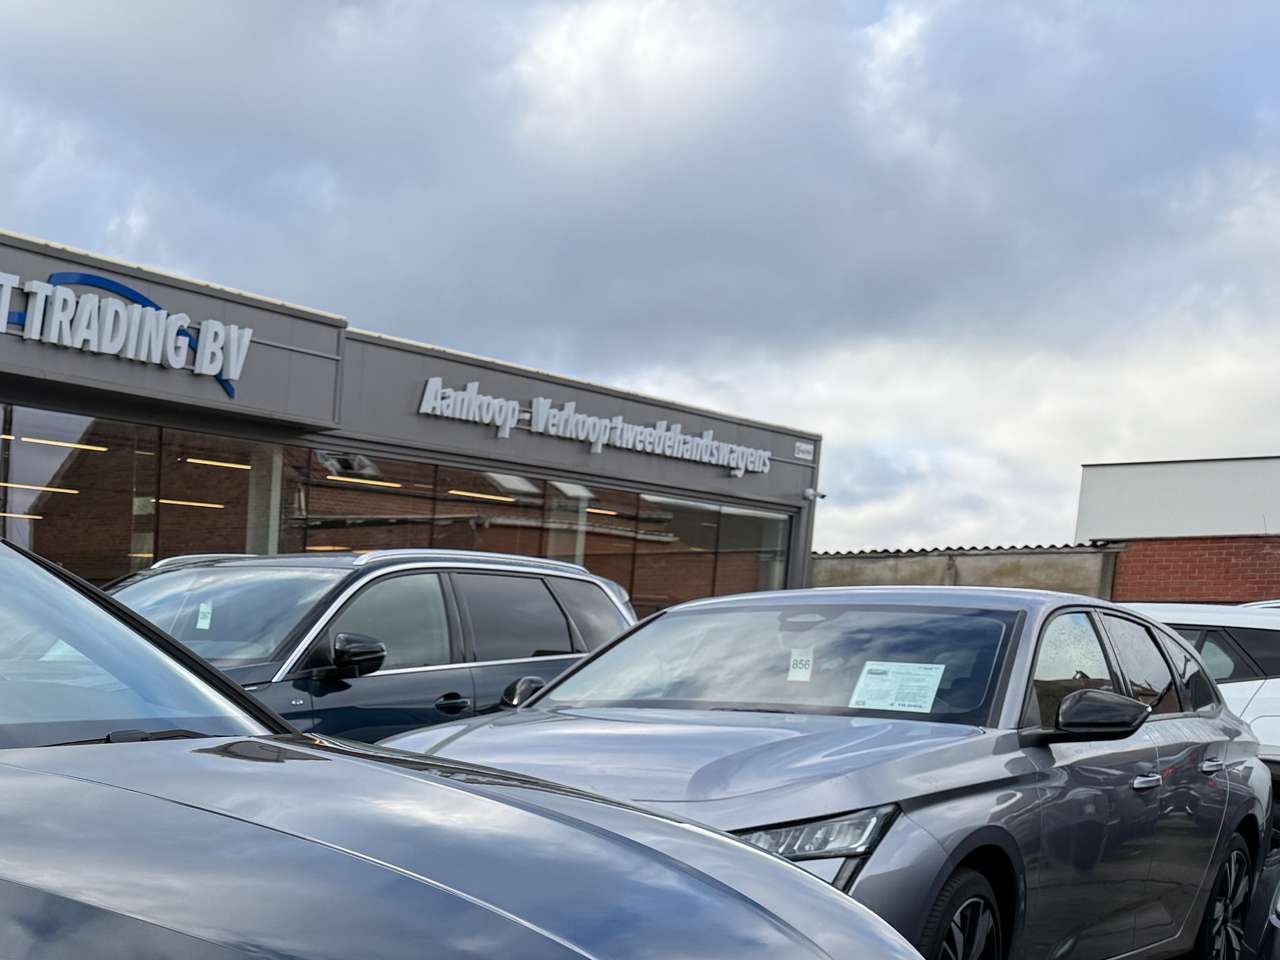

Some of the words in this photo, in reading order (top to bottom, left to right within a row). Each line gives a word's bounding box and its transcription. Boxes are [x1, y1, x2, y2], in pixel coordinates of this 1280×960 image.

[23, 279, 191, 370] TRADING
[194, 319, 254, 381] BV
[419, 376, 520, 439] Aankoop
[531, 396, 611, 454] Verkoop
